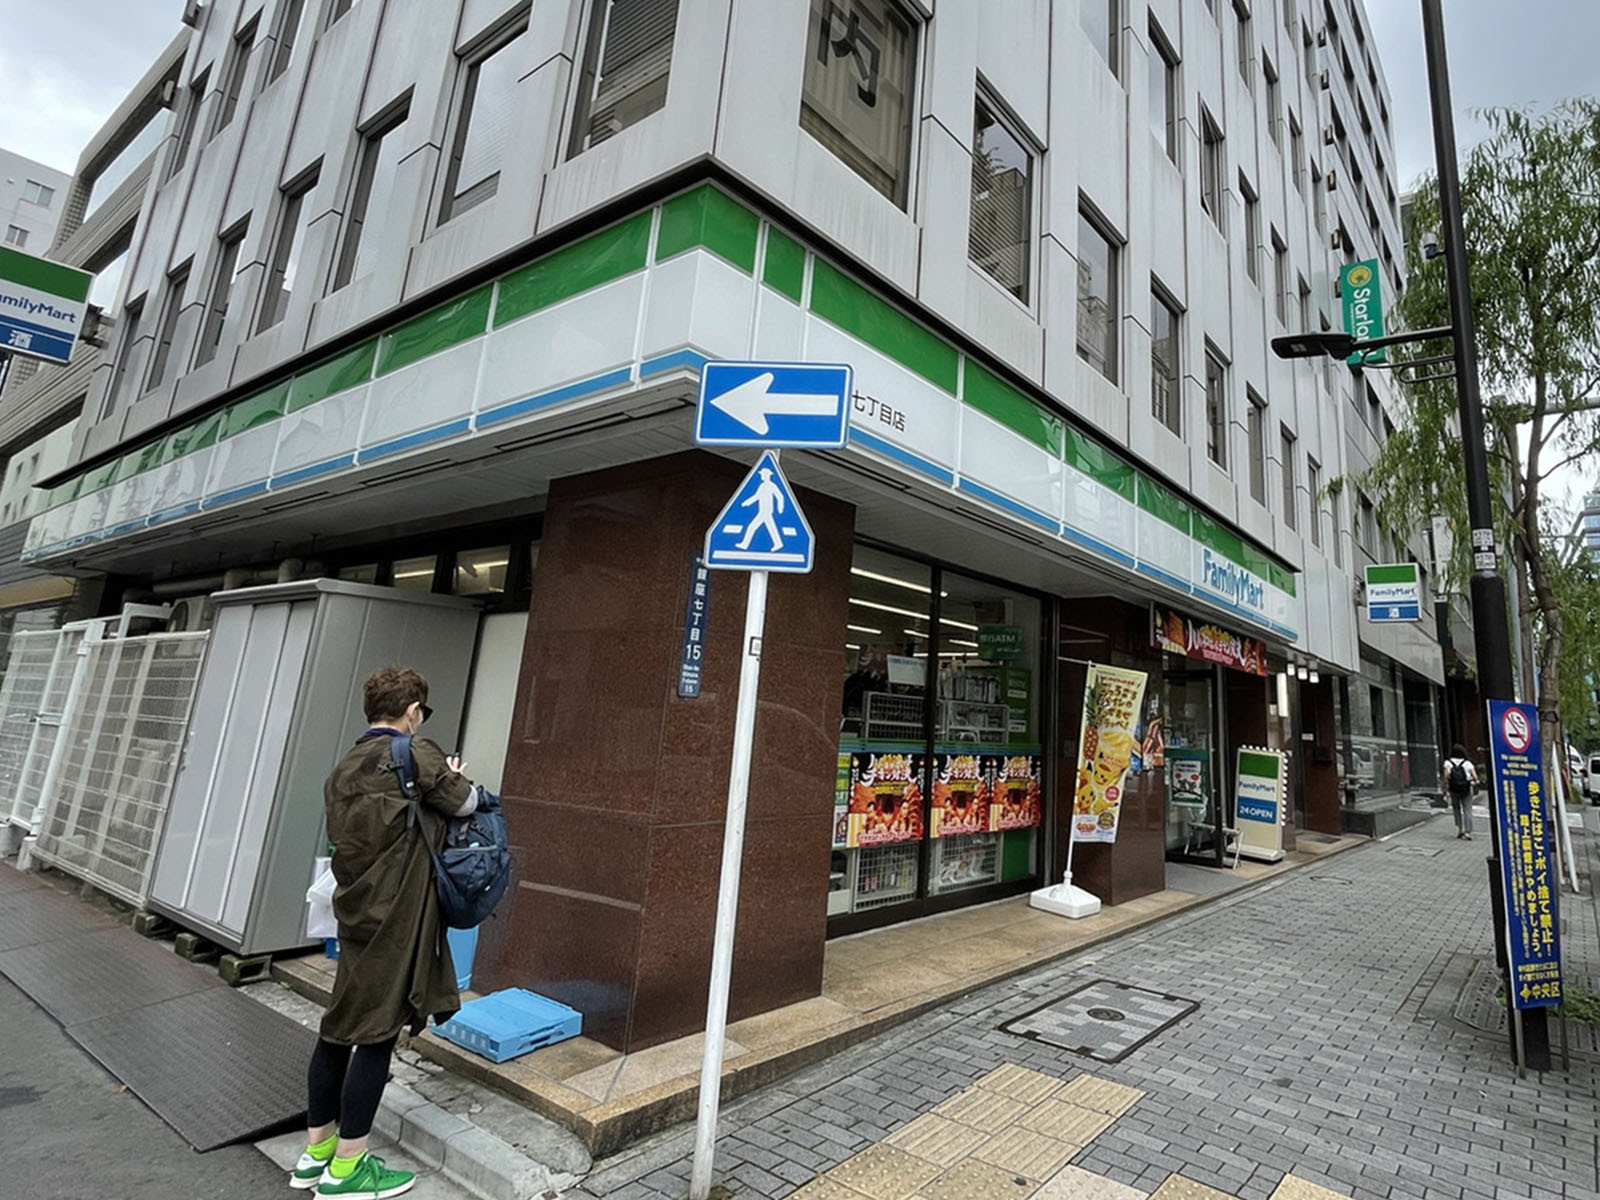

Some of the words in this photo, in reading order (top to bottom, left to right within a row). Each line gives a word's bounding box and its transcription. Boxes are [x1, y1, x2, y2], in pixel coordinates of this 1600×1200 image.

[852, 389, 906, 432] 七丁目店
[1203, 548, 1264, 610] FamilyMart
[1370, 587, 1415, 597] FamilyMart
[686, 644, 701, 660] 15
[1239, 780, 1275, 792] FamilyMart
[1532, 981, 1560, 1000] 中央区
